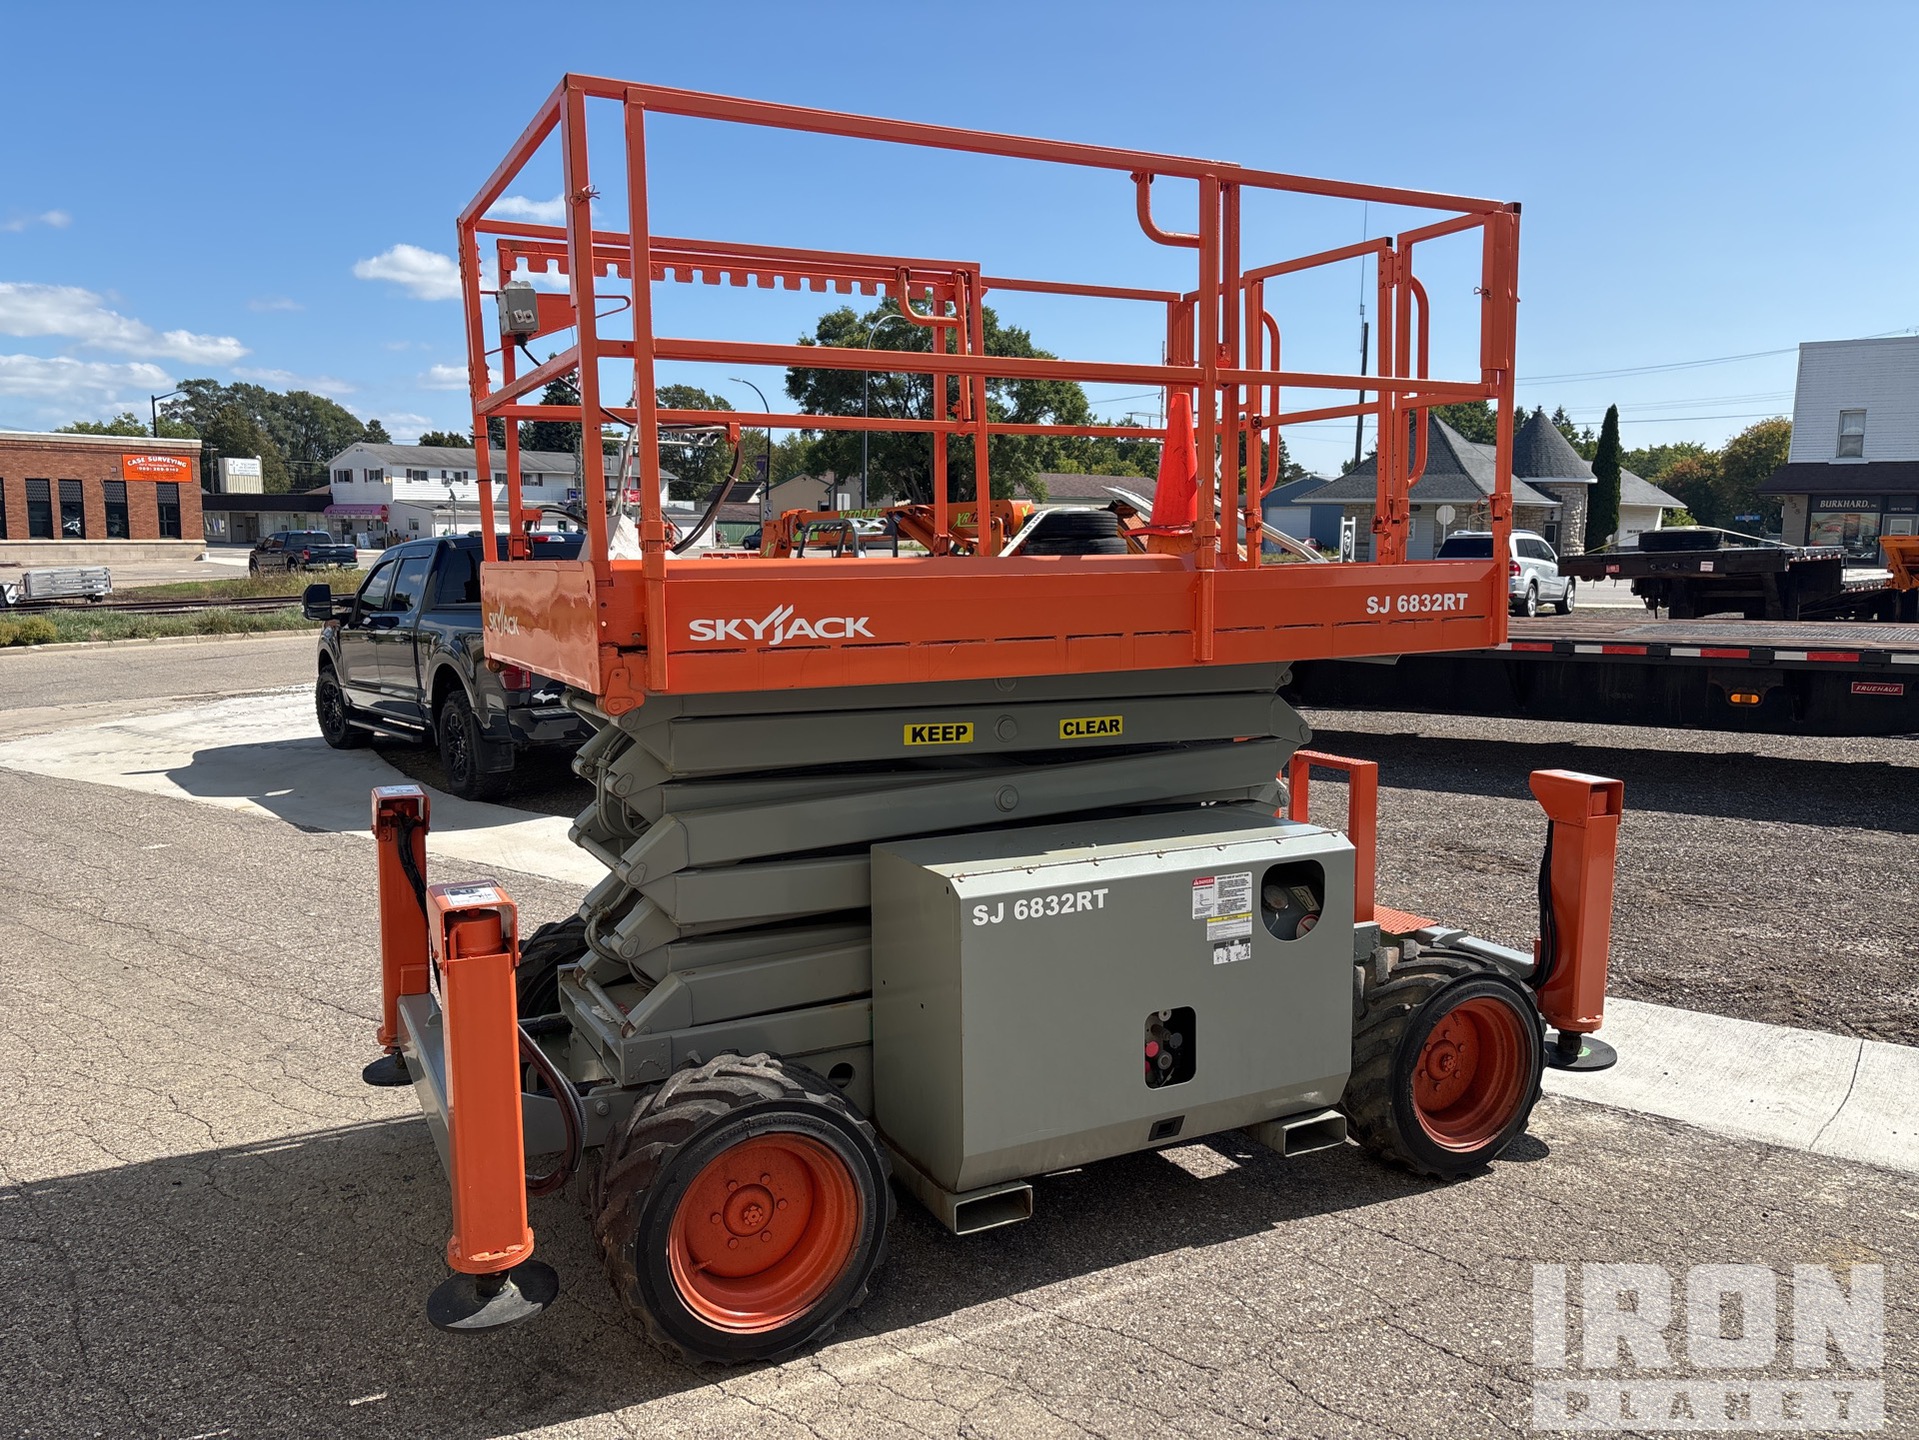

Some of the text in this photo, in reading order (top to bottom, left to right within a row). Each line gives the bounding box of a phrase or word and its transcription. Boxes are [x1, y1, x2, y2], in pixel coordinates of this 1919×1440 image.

[127, 456, 187, 468] CASE SURVEYING
[1366, 593, 1469, 614] SJ 6832RT
[488, 600, 520, 637] SKYJACK
[689, 603, 876, 646] SKYJACK
[911, 725, 968, 742] KEEP
[1063, 719, 1120, 736] CLEAR
[972, 888, 1109, 926] SJ 6832RT
